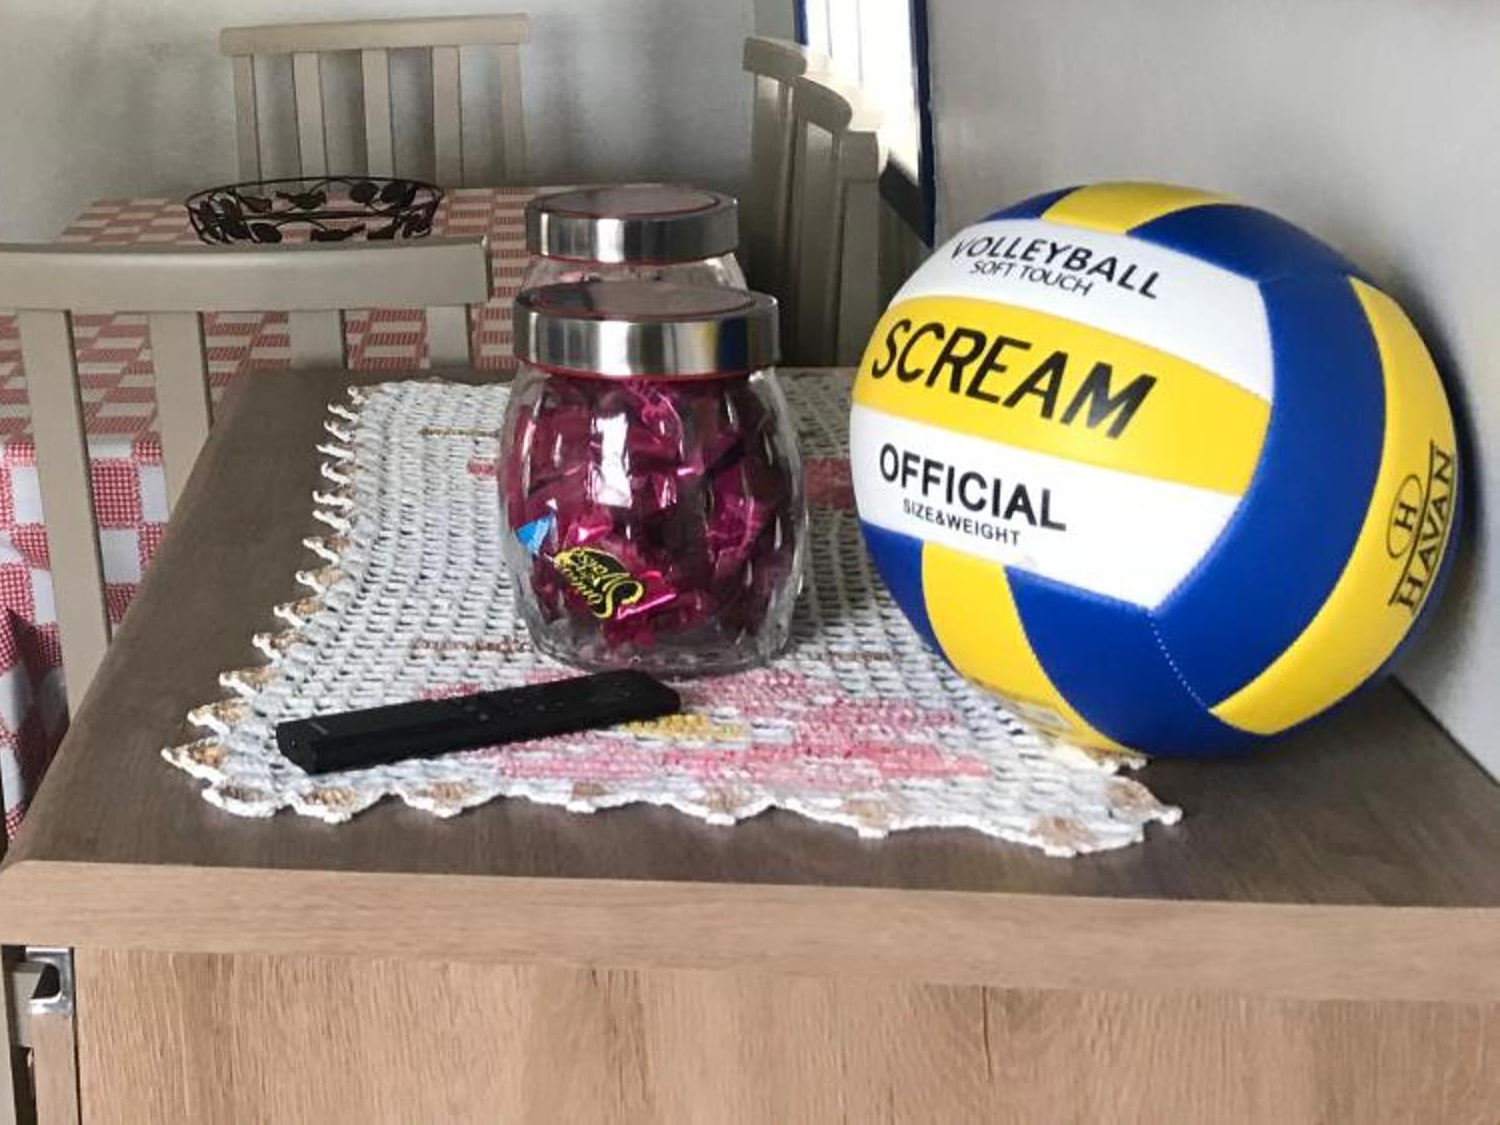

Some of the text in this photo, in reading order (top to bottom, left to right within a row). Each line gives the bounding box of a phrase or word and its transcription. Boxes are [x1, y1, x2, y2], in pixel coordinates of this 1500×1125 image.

[951, 235, 1160, 300] VOLLEYBALL
[969, 259, 1095, 297] SOFT TOUCH
[871, 317, 1158, 441] SCREAM
[879, 442, 1067, 532] OFFICIAL
[902, 497, 1021, 546] SIZE&WEIGHT
[1396, 445, 1453, 608] HAVAN
